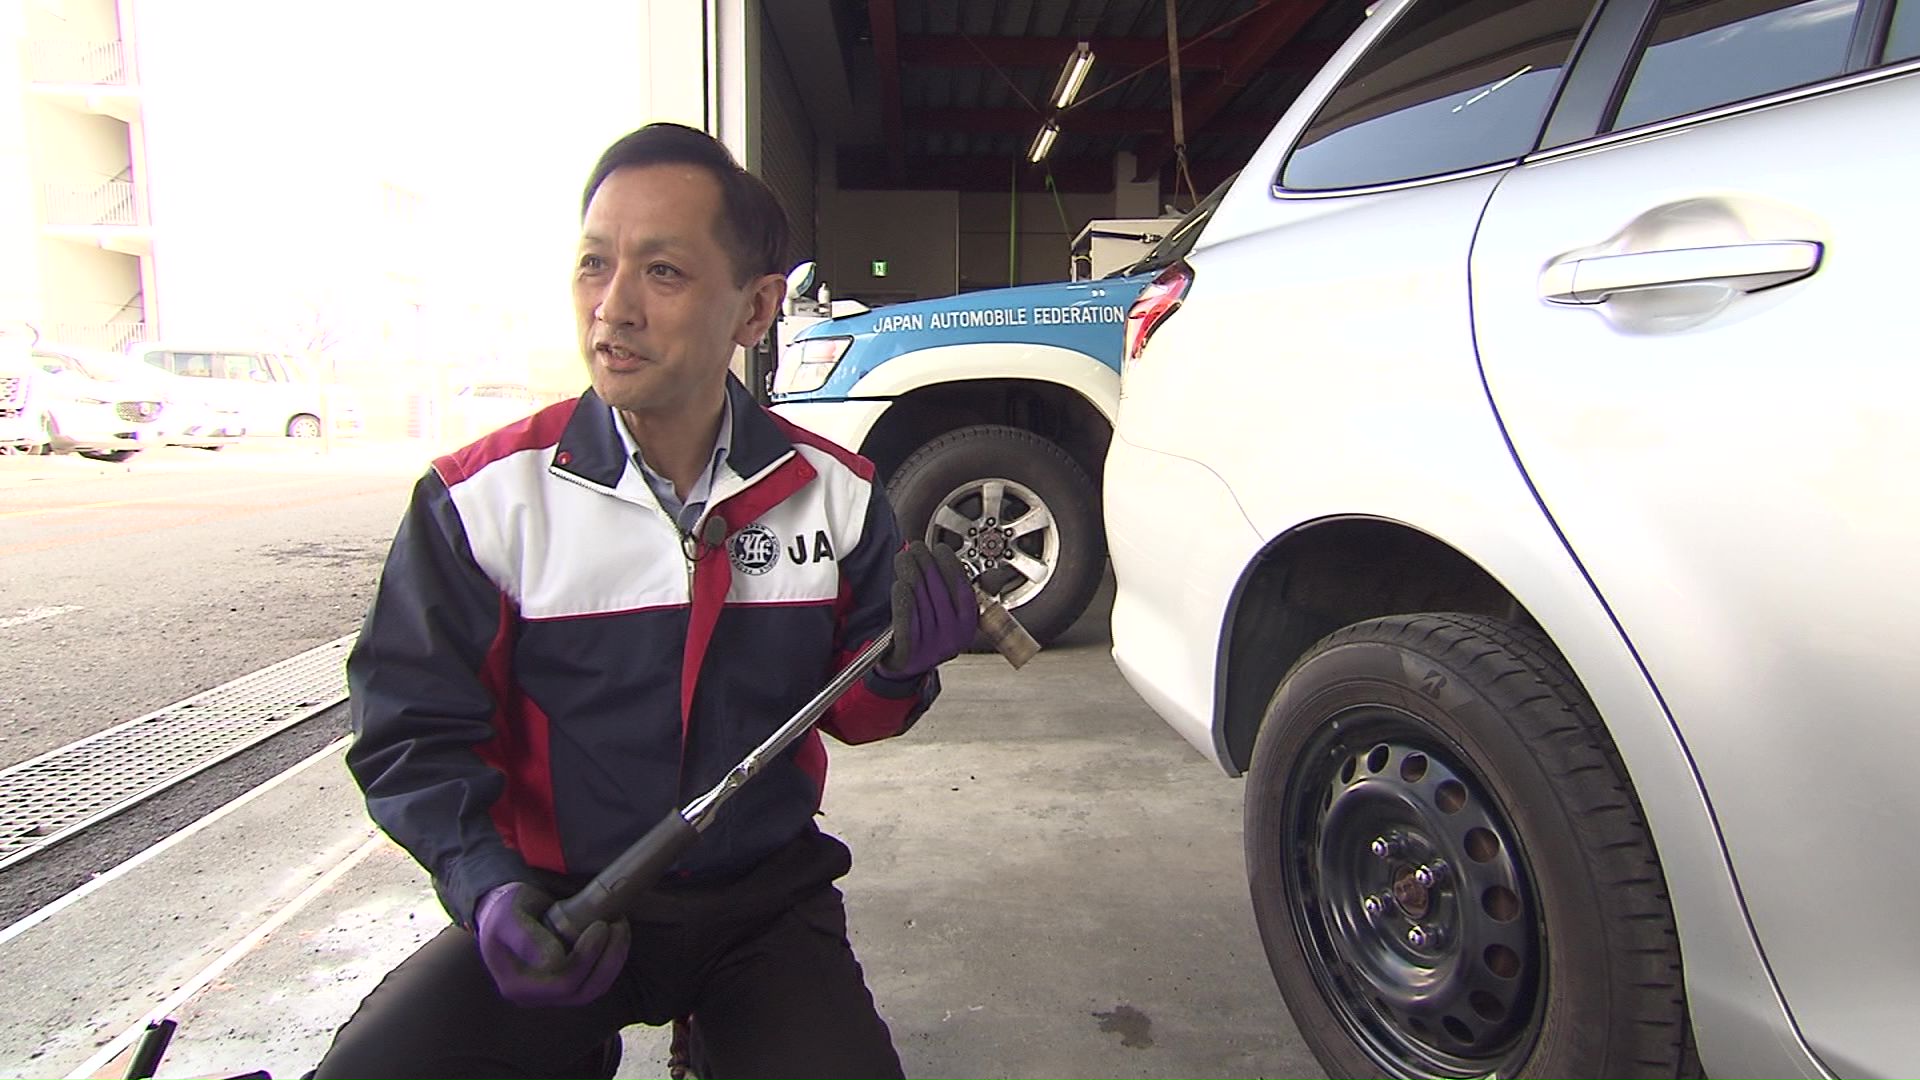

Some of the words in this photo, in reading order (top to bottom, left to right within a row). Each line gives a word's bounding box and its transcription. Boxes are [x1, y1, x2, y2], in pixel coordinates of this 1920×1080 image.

[873, 314, 923, 333] JAPAN
[930, 308, 1028, 330] AUTOMOBILE
[1033, 306, 1125, 324] FEDERATION
